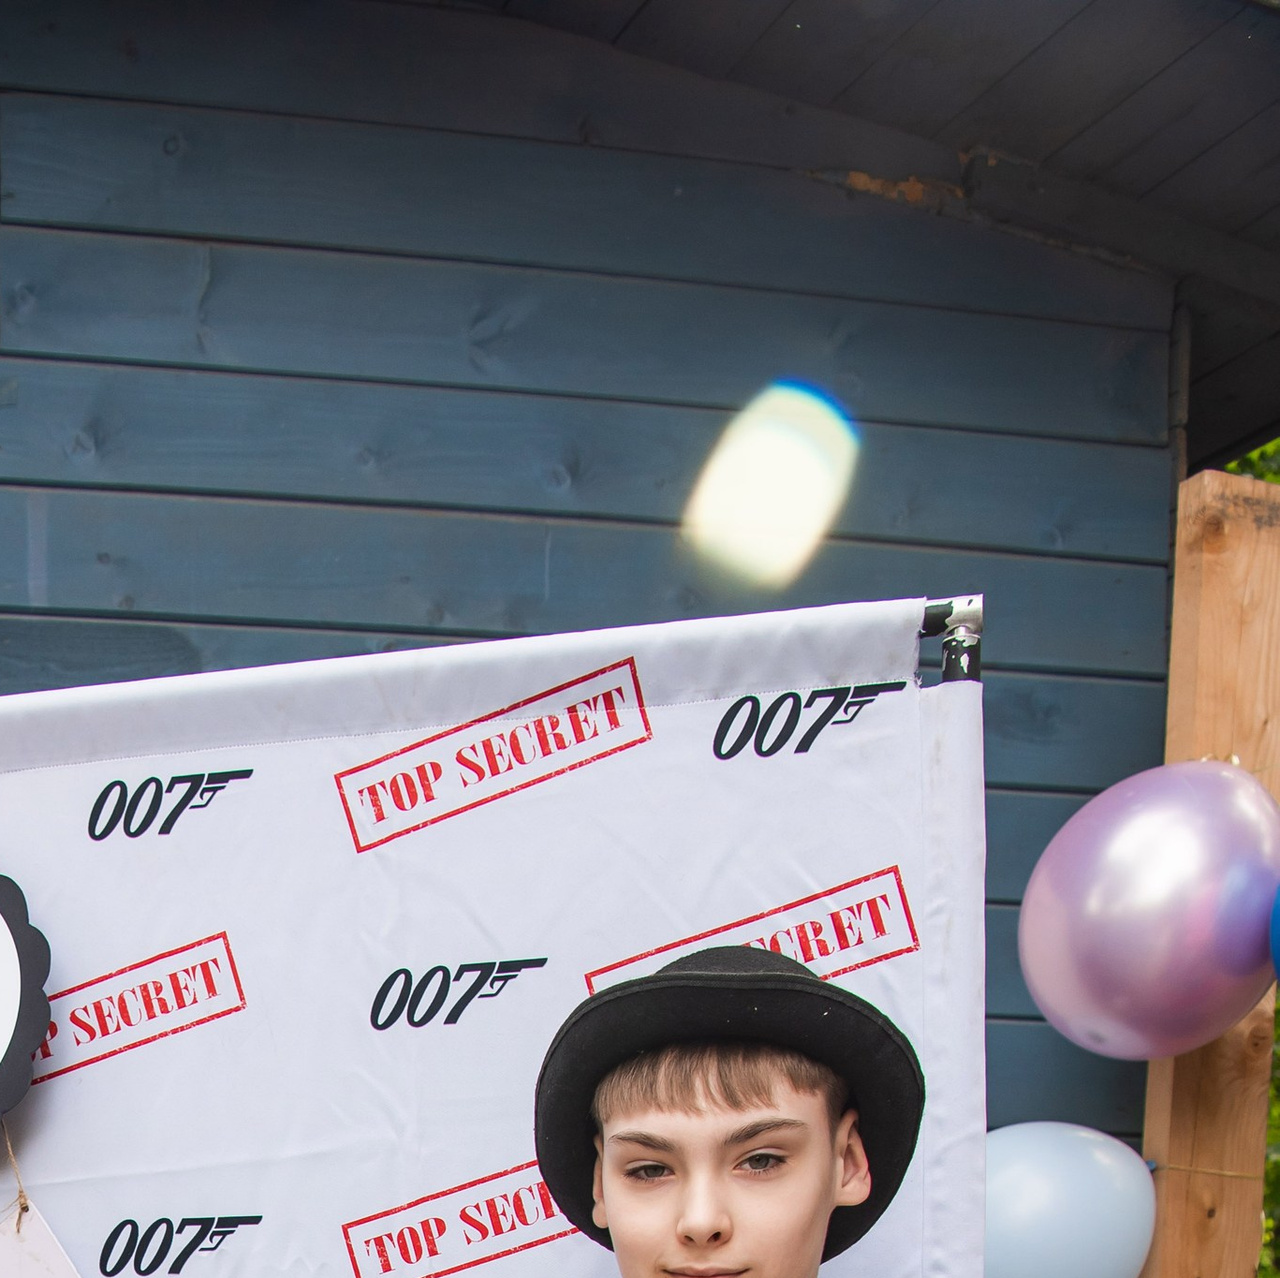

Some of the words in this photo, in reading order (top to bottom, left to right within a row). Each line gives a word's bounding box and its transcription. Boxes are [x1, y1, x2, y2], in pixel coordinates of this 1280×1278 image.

[357, 760, 443, 824] TOP
[454, 686, 625, 788] SECRET
[712, 681, 907, 761] 007
[87, 769, 254, 841] 007
[742, 893, 891, 965] CRET
[68, 957, 221, 1047] SECRET
[369, 957, 548, 1030] 007
[98, 1214, 263, 1278] 007
[363, 1216, 447, 1274] TOP
